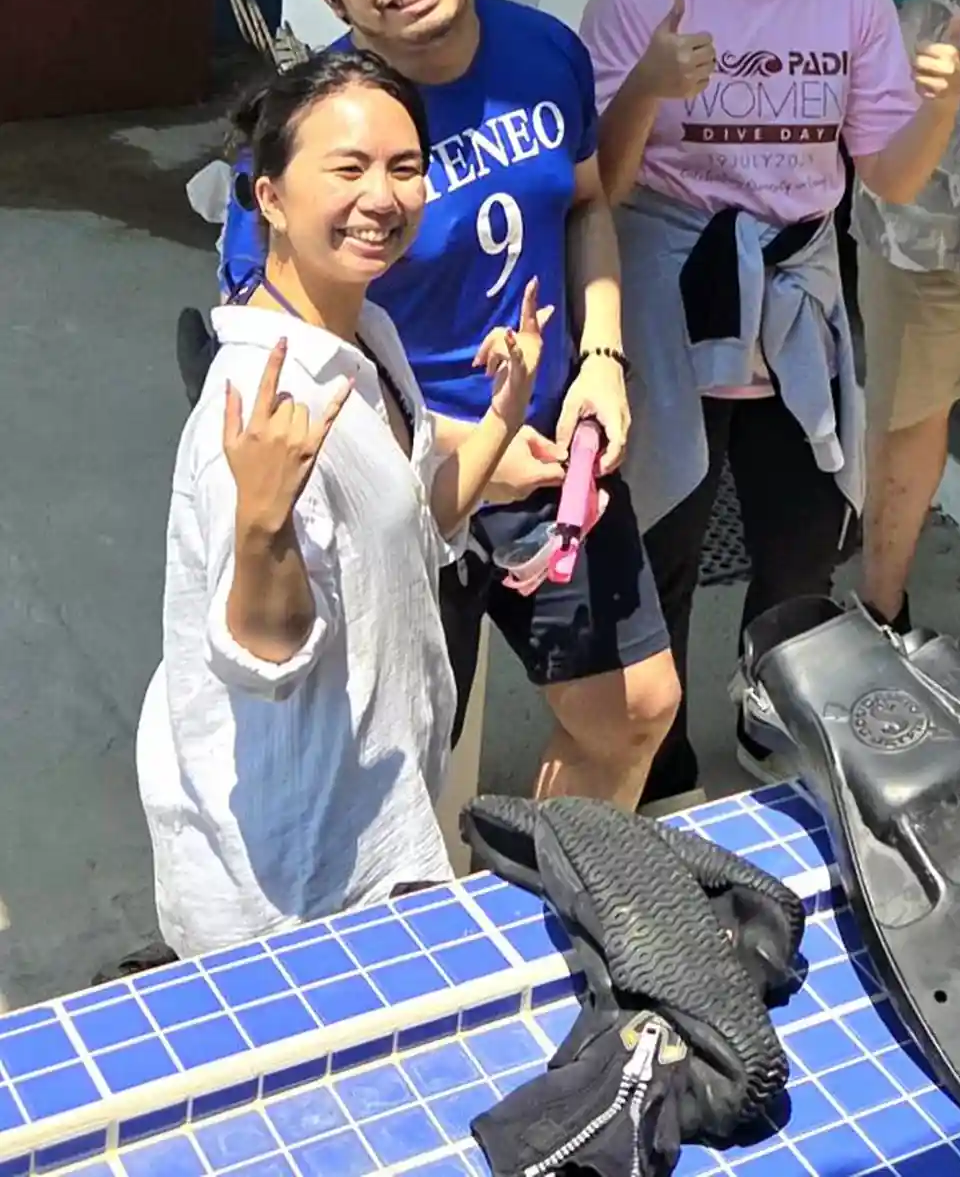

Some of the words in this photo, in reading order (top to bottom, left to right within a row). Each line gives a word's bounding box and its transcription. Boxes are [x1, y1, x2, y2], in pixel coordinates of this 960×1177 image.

[788, 50, 848, 76] PADI
[703, 128, 764, 141] DIVE
[780, 127, 826, 141] DAY
[476, 192, 524, 298] 9
